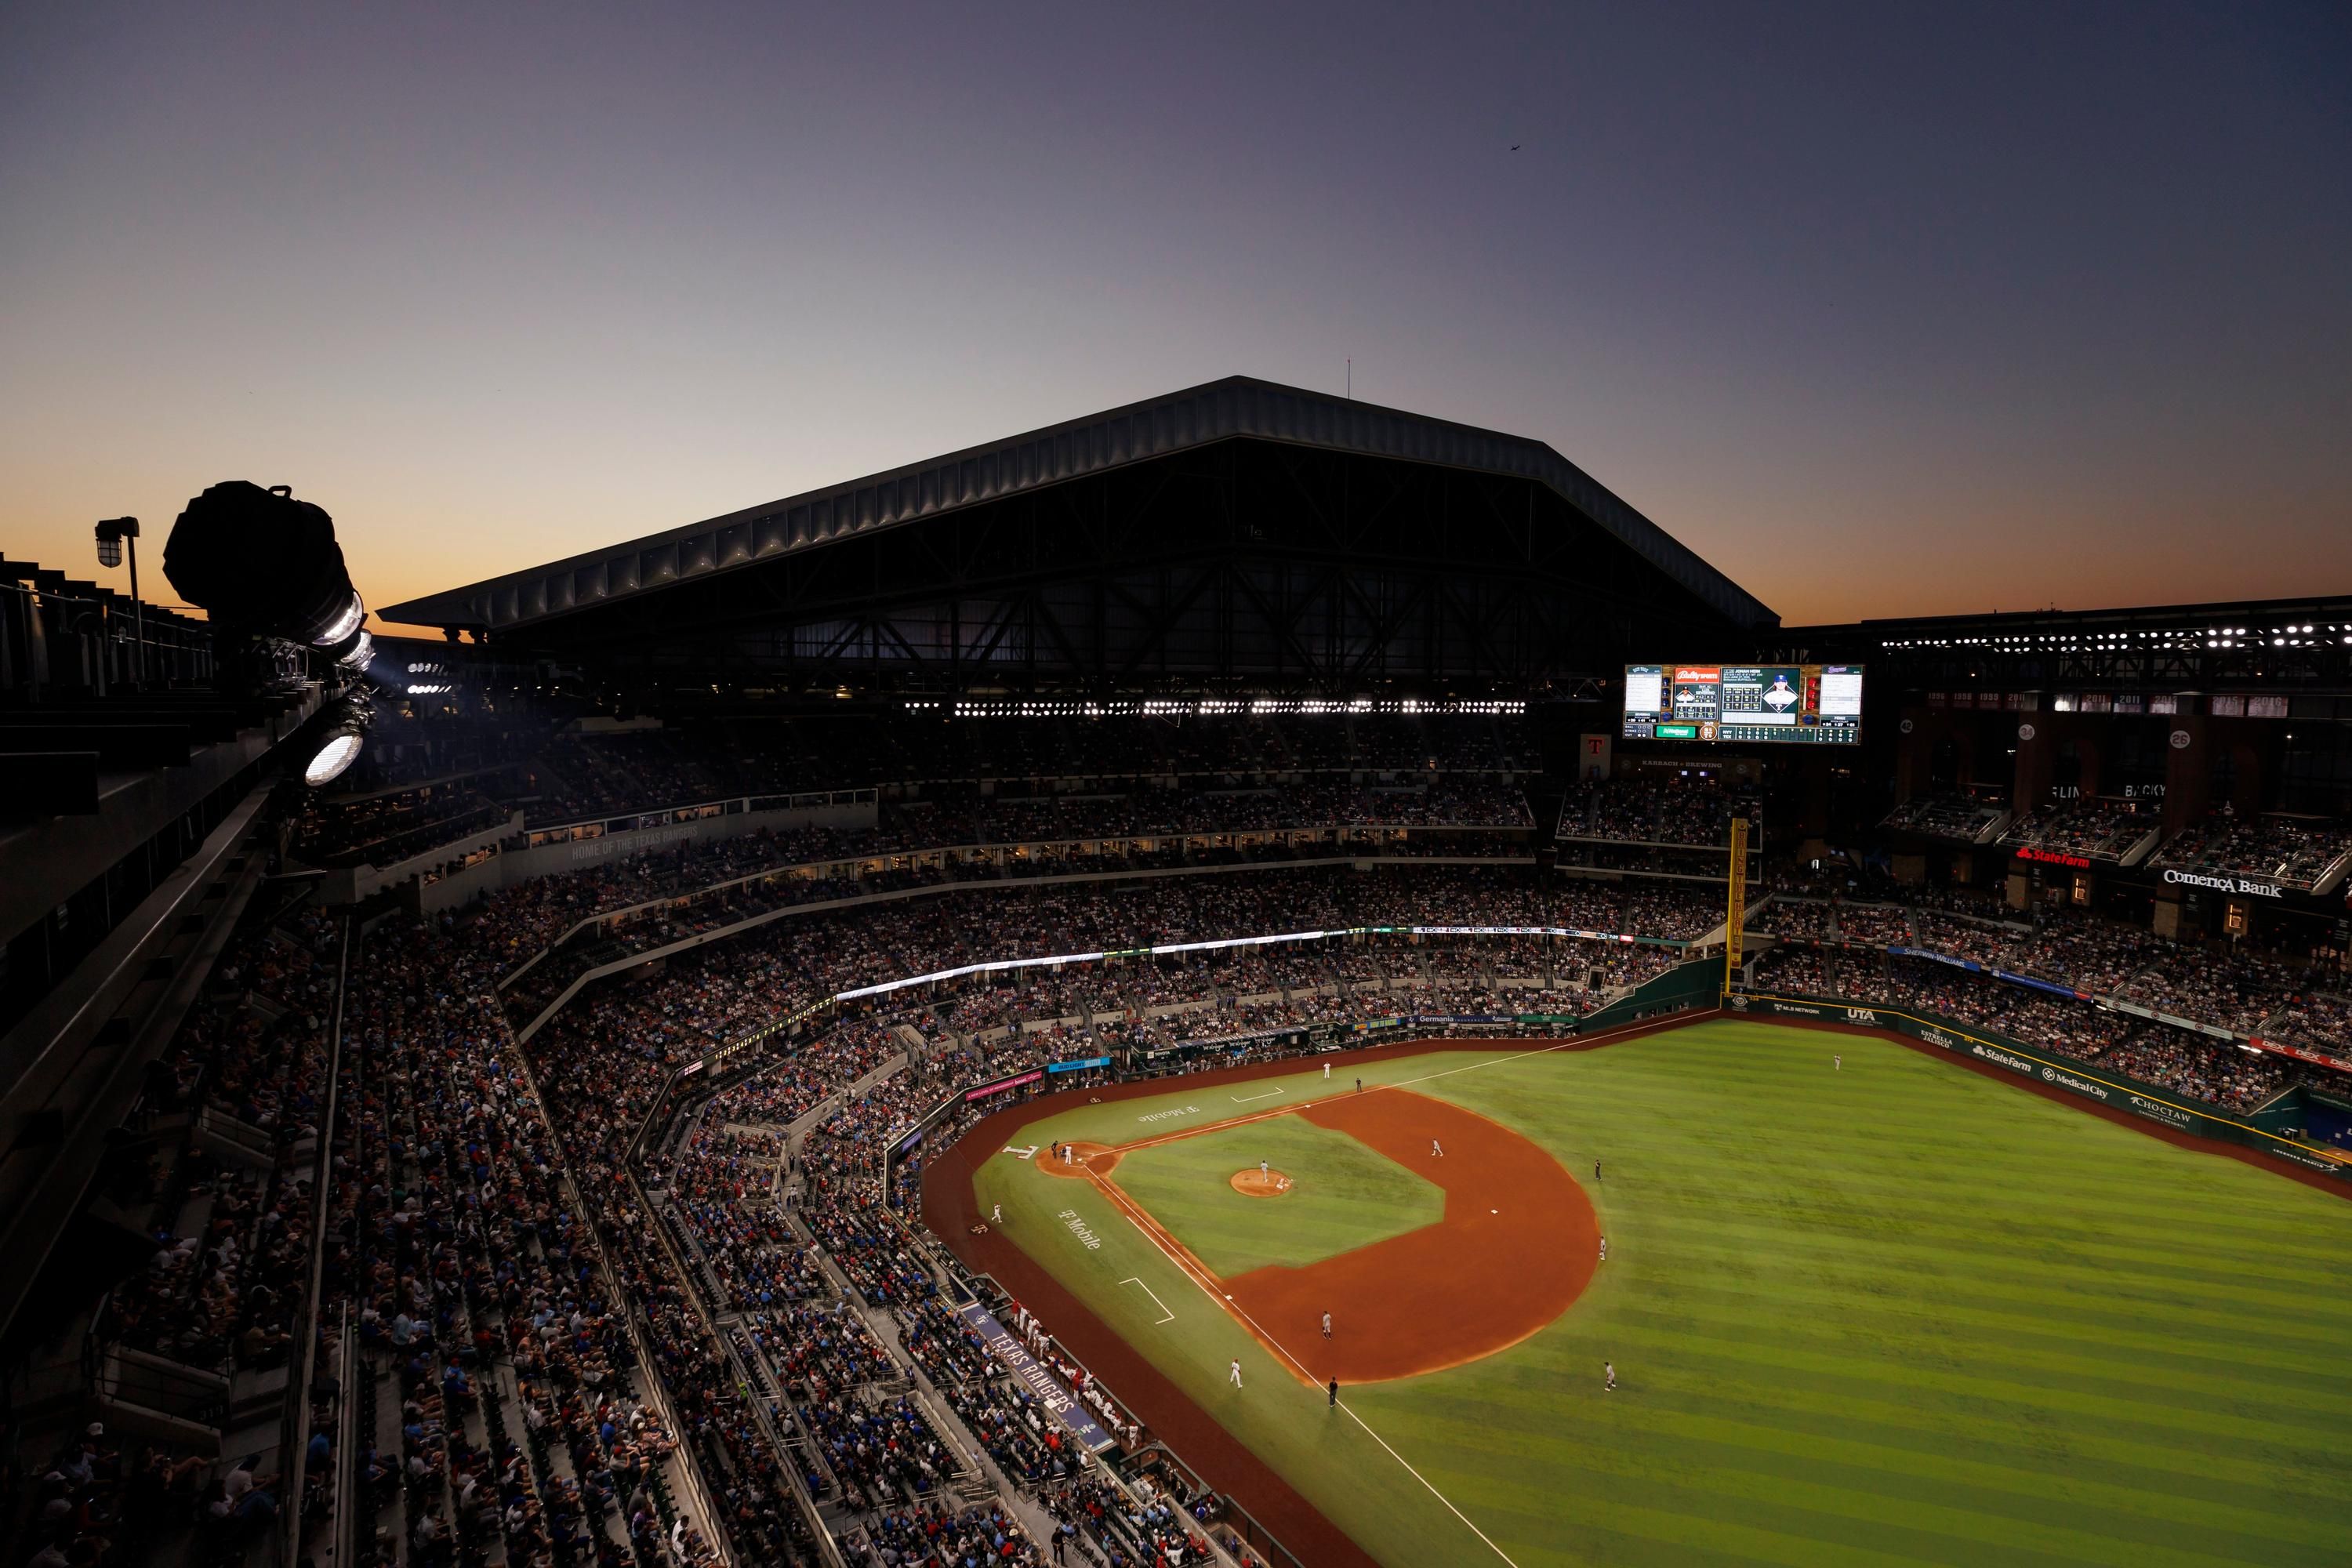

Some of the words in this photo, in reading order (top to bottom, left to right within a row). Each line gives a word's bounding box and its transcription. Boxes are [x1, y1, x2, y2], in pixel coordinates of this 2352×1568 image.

[1677, 670, 1700, 681] Bally
[2086, 695, 2107, 703] 2011
[2120, 695, 2140, 704] 2011
[2254, 696, 2281, 706] 2016
[2020, 728, 2033, 736] 34
[1587, 737, 1605, 755] T
[2172, 735, 2187, 745] 26
[572, 843, 601, 860] HOME
[603, 840, 615, 855] OF
[616, 837, 633, 851] THE
[636, 833, 660, 848] TEXAS
[662, 826, 698, 843] RANGERS
[2238, 880, 2283, 898] Bank
[1847, 1008, 1876, 1022] UTA
[1921, 1029, 1953, 1045] ESTRELLA
[1923, 1036, 1950, 1049] JALISCO
[2262, 1040, 2286, 1051] DEX
[2296, 1049, 2321, 1061] DEX
[2056, 1074, 2089, 1092] Medical
[2089, 1085, 2108, 1099] City
[2136, 1097, 2191, 1123] CHOCTAW
[2138, 1109, 2159, 1120] CASINOS
[2164, 1119, 2187, 1129] RESORTS
[992, 1333, 1029, 1366] TEXAS
[1021, 1364, 1074, 1413] RANGERS
